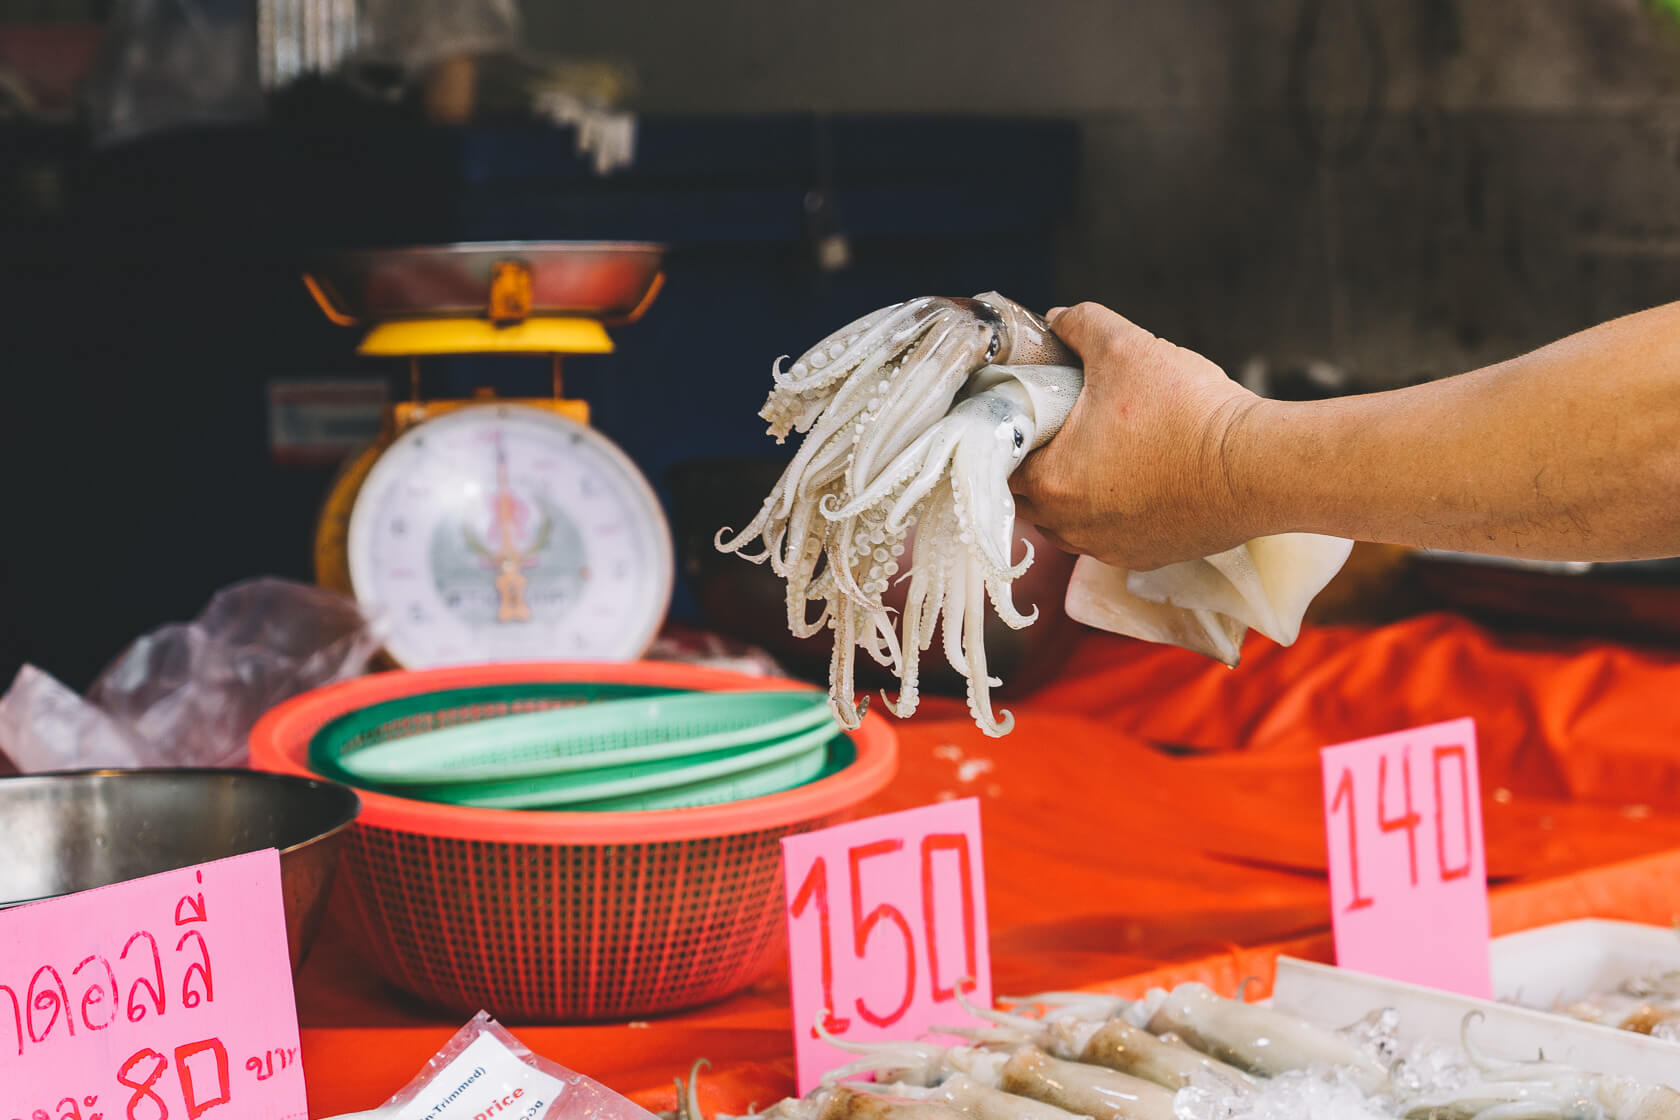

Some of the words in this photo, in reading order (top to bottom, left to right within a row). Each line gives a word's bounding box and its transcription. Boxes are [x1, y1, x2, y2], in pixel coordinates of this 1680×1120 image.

[1331, 745, 1472, 914] 140
[791, 834, 977, 1038] 150
[117, 1037, 230, 1120] 80
